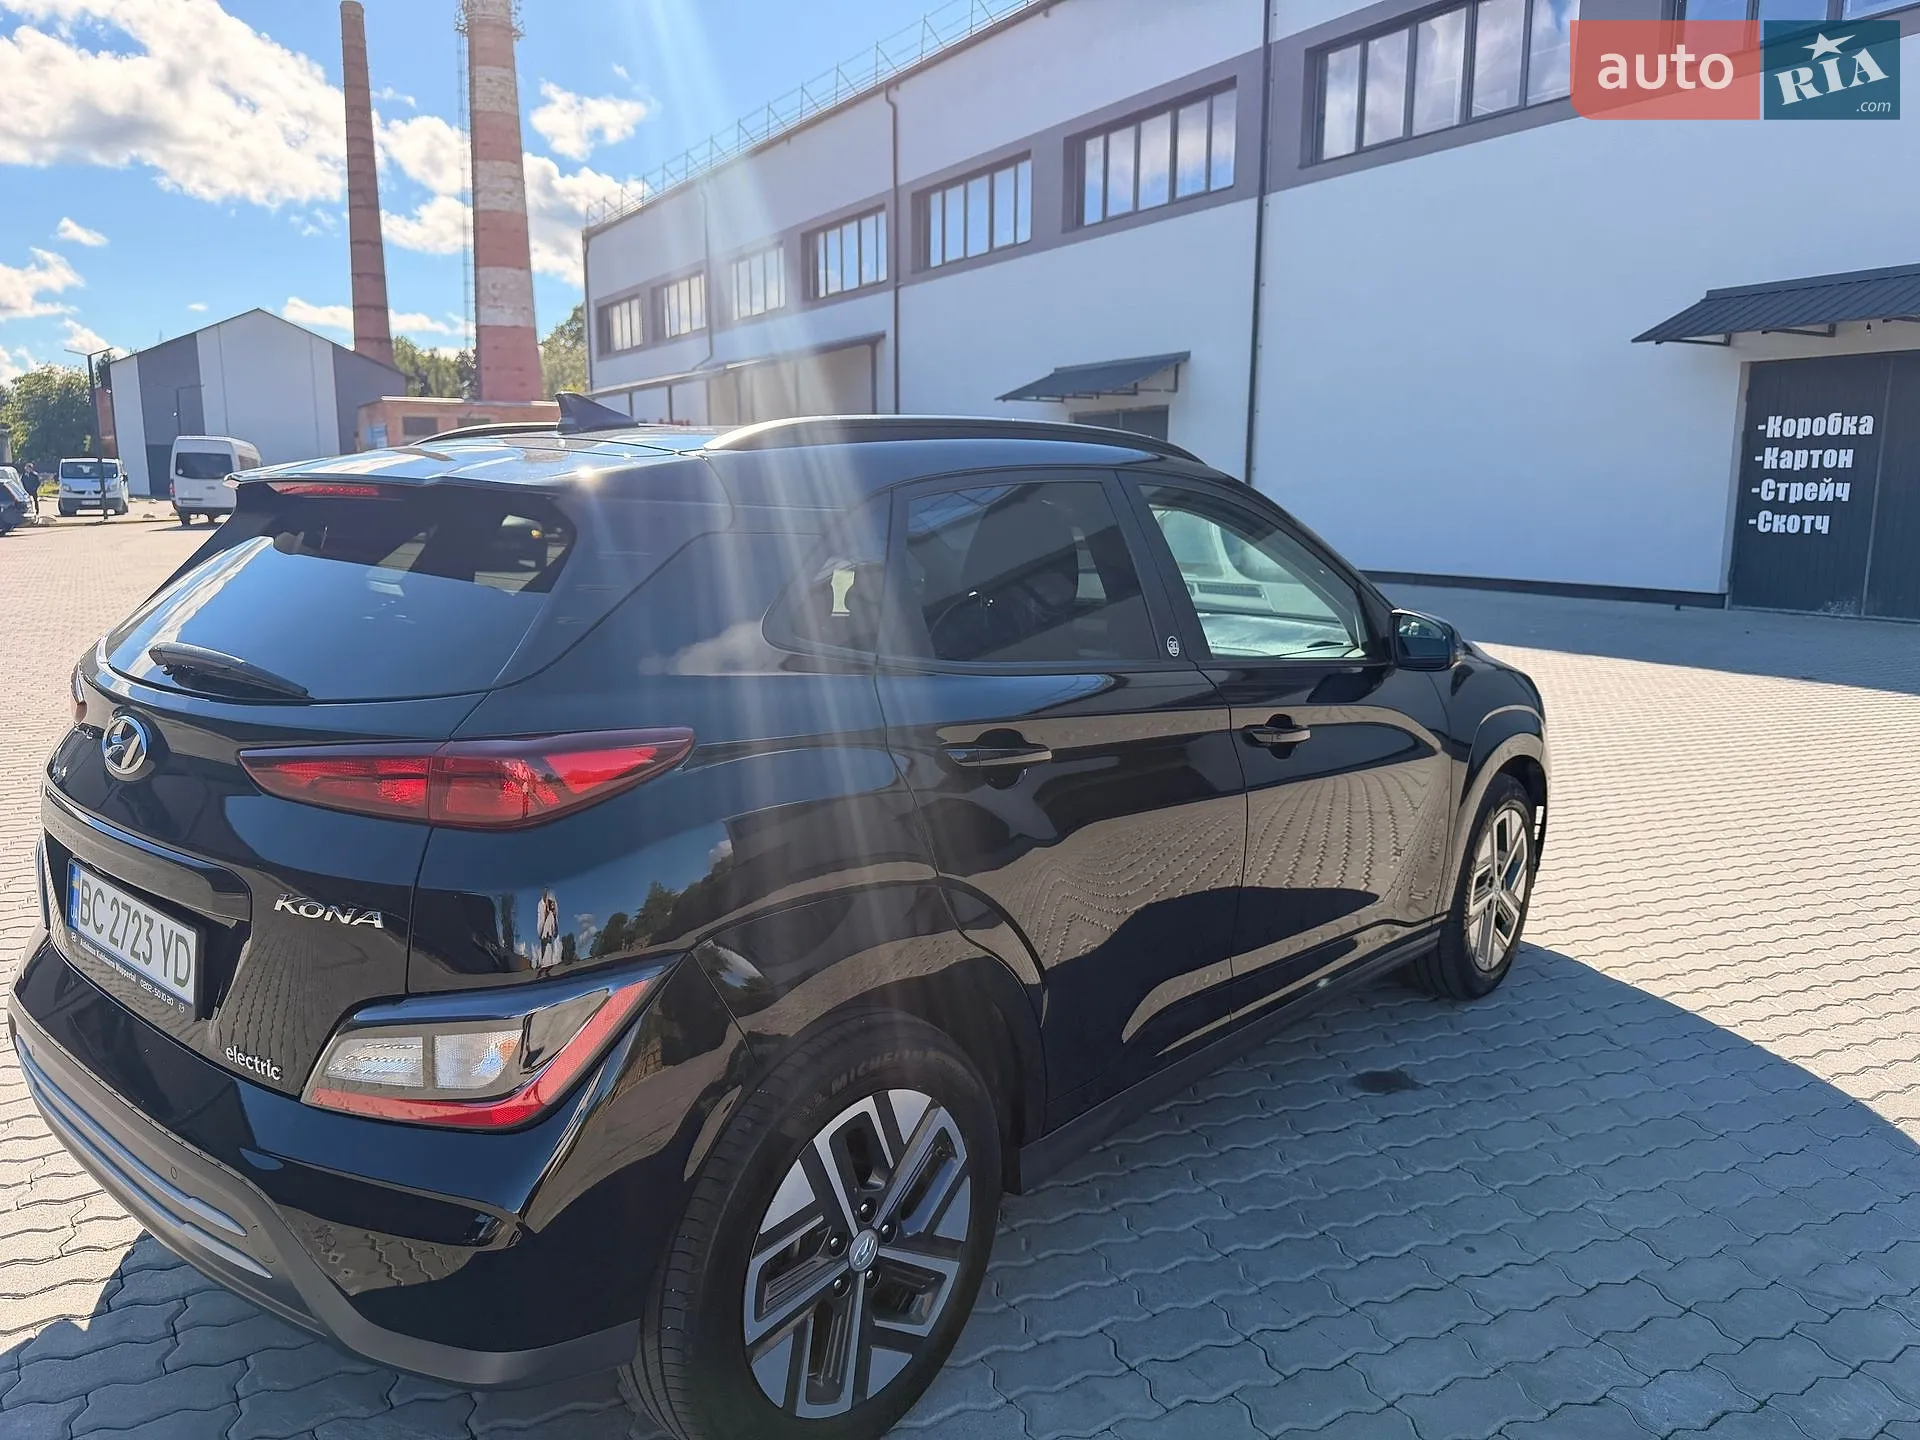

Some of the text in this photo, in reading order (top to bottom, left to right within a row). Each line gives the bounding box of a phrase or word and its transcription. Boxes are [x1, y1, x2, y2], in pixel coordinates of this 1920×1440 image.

[1757, 412, 1875, 439] -Коробка
[1754, 447, 1854, 471] -Картон
[1751, 477, 1851, 503] -Стрейч
[1748, 510, 1830, 534] -Скотч
[273, 892, 384, 929] KONA
[80, 880, 105, 935] BC
[108, 897, 154, 966] 2723
[160, 923, 191, 988] YD
[225, 1045, 282, 1081] electric
[831, 1049, 924, 1095] MICHELIN
